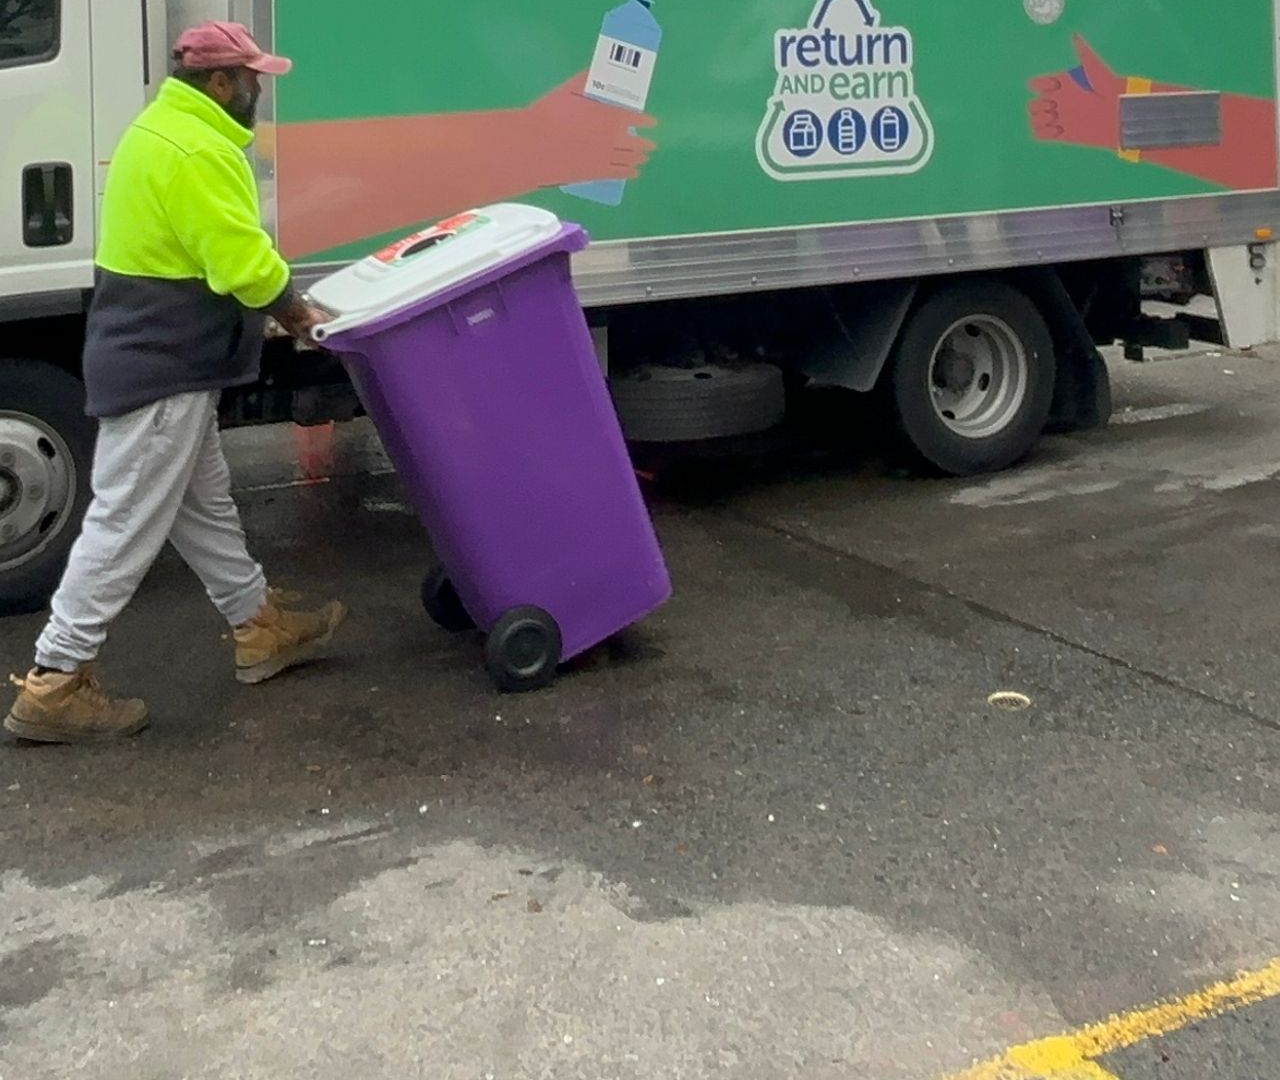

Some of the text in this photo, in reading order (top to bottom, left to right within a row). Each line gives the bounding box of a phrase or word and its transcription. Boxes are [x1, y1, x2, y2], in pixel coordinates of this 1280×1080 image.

[780, 28, 907, 67] return
[780, 69, 909, 100] AND earn
